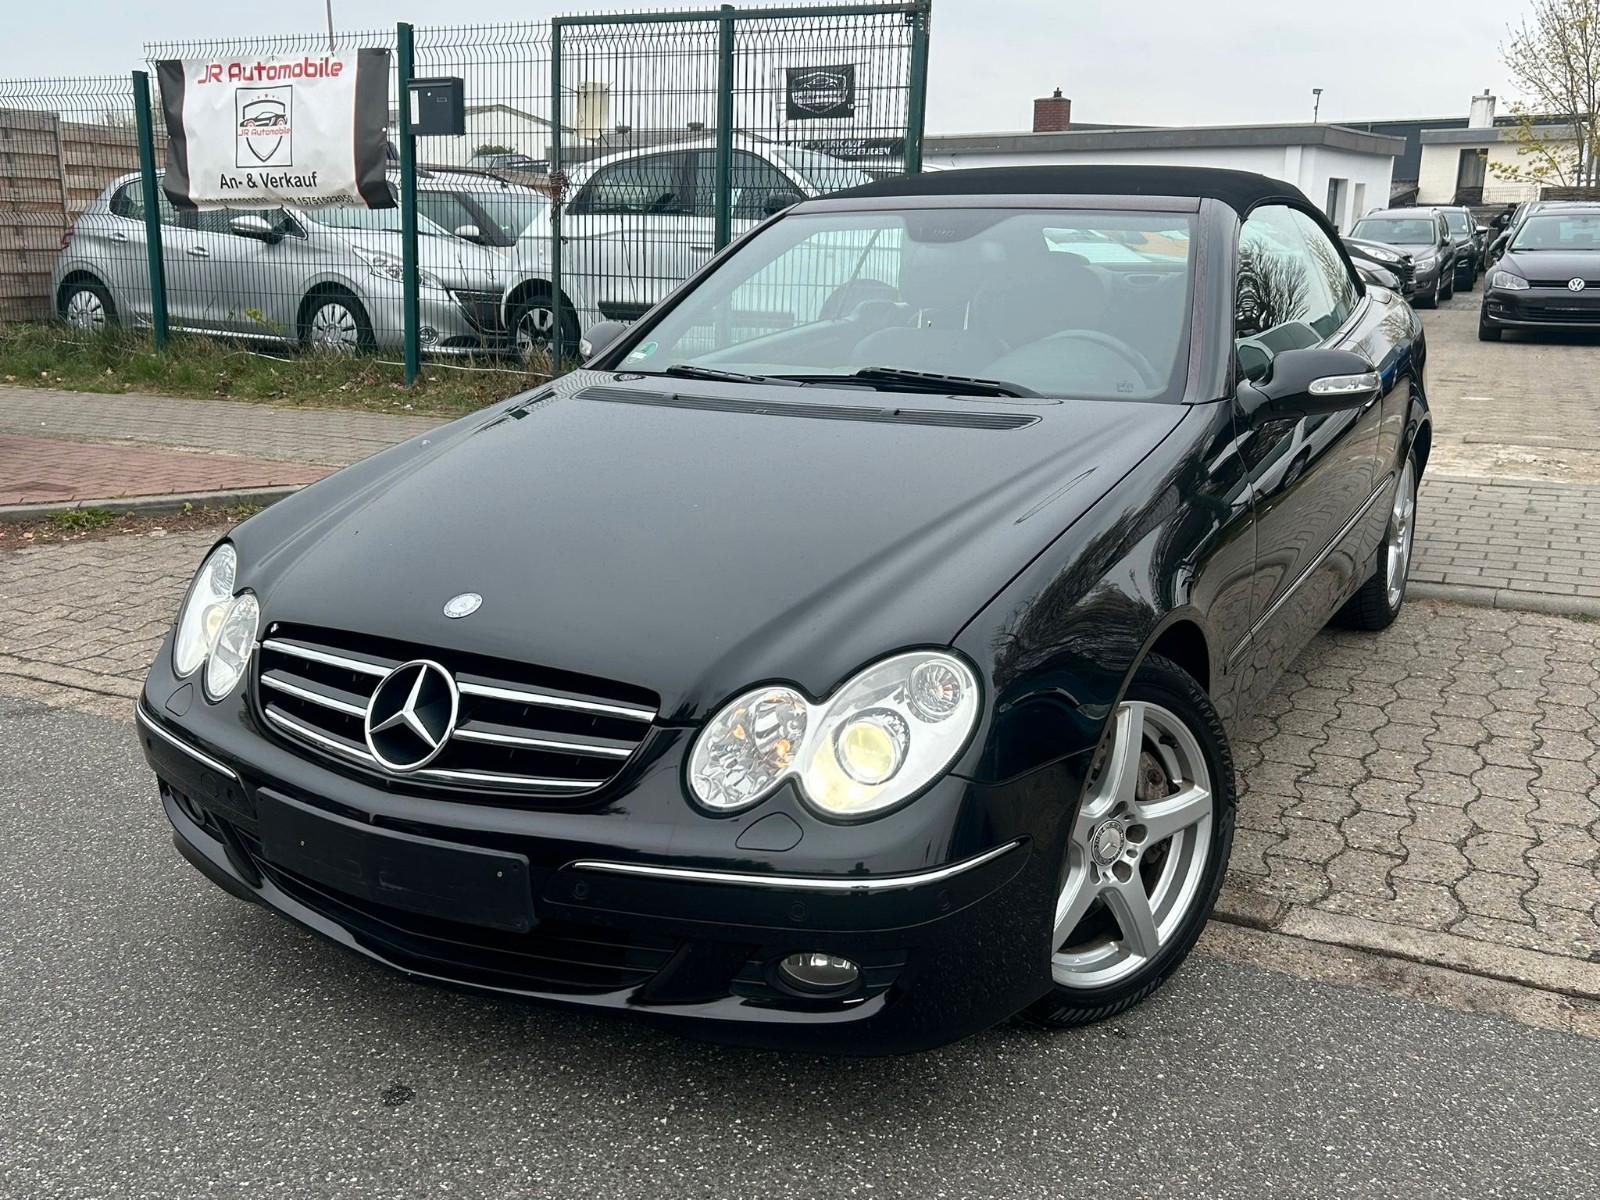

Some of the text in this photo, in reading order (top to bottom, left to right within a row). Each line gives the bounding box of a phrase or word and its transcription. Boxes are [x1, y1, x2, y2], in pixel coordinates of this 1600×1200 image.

[197, 56, 343, 84] JR Automobile
[238, 127, 291, 137] JR Automobile
[220, 171, 318, 190] An- & Verkauf
